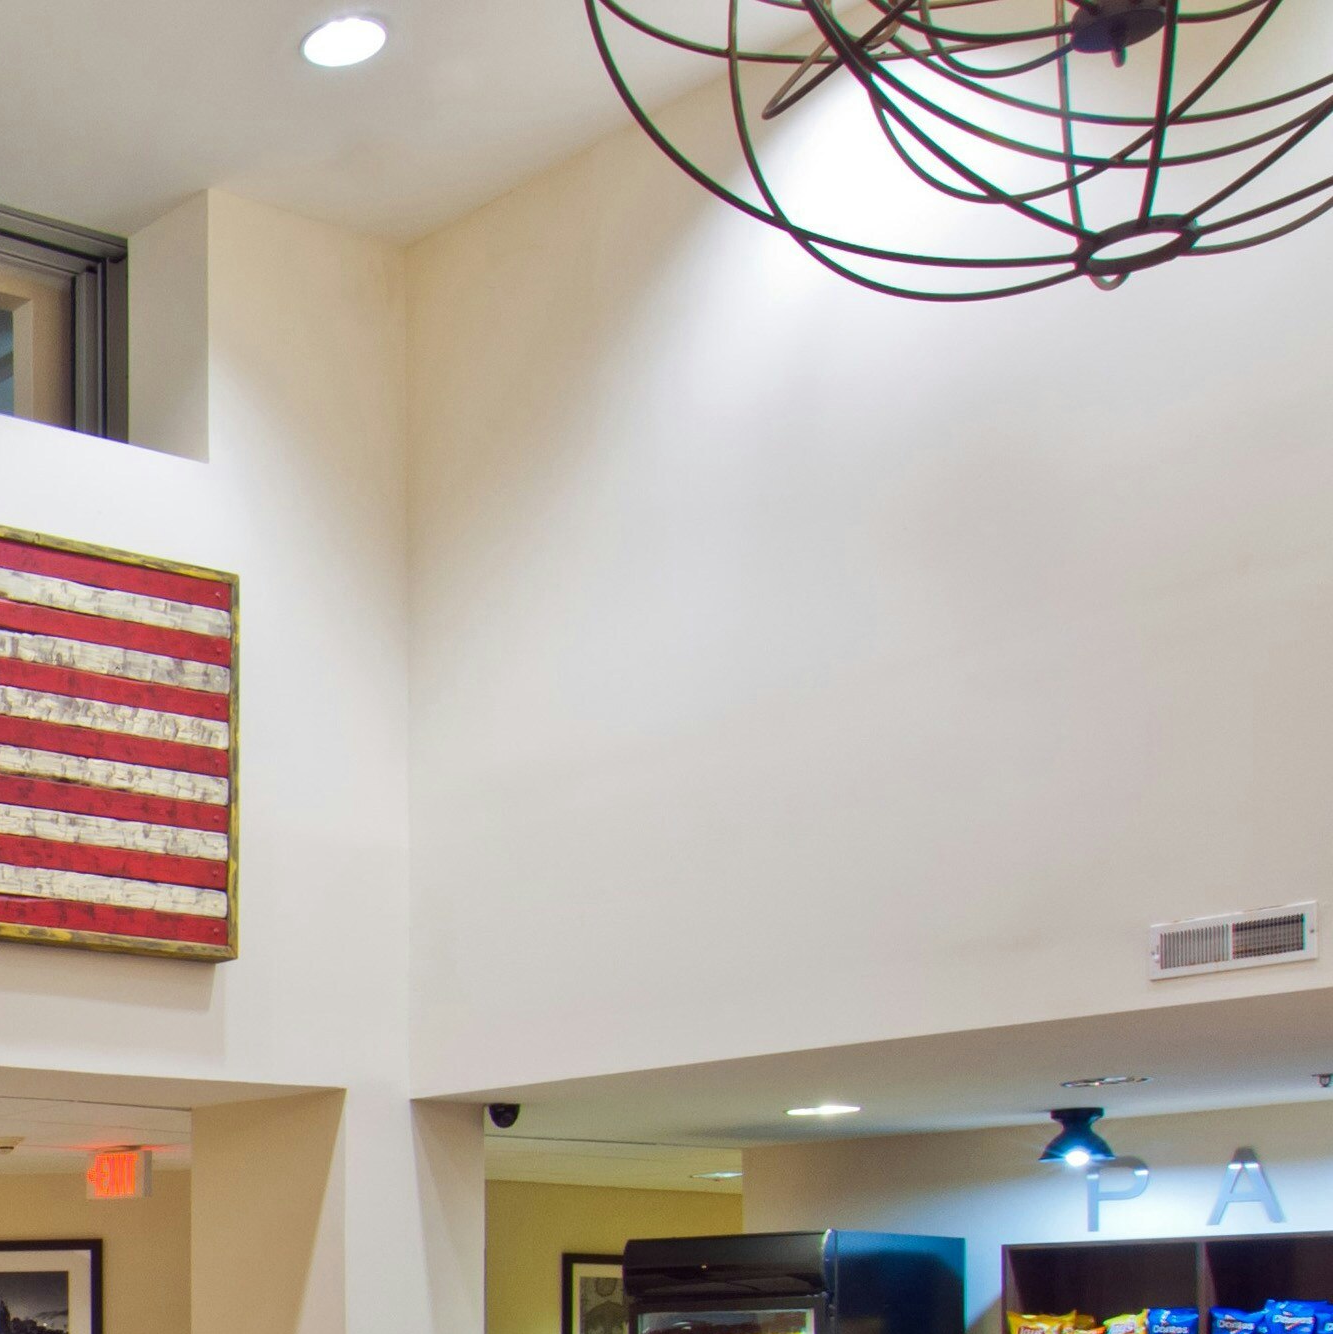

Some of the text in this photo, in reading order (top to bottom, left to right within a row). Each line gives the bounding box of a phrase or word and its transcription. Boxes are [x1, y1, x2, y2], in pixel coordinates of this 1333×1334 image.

[95, 1153, 136, 1197] EXIT
[1153, 1324, 1189, 1334] Doritos
[1217, 1320, 1255, 1331] Doritos
